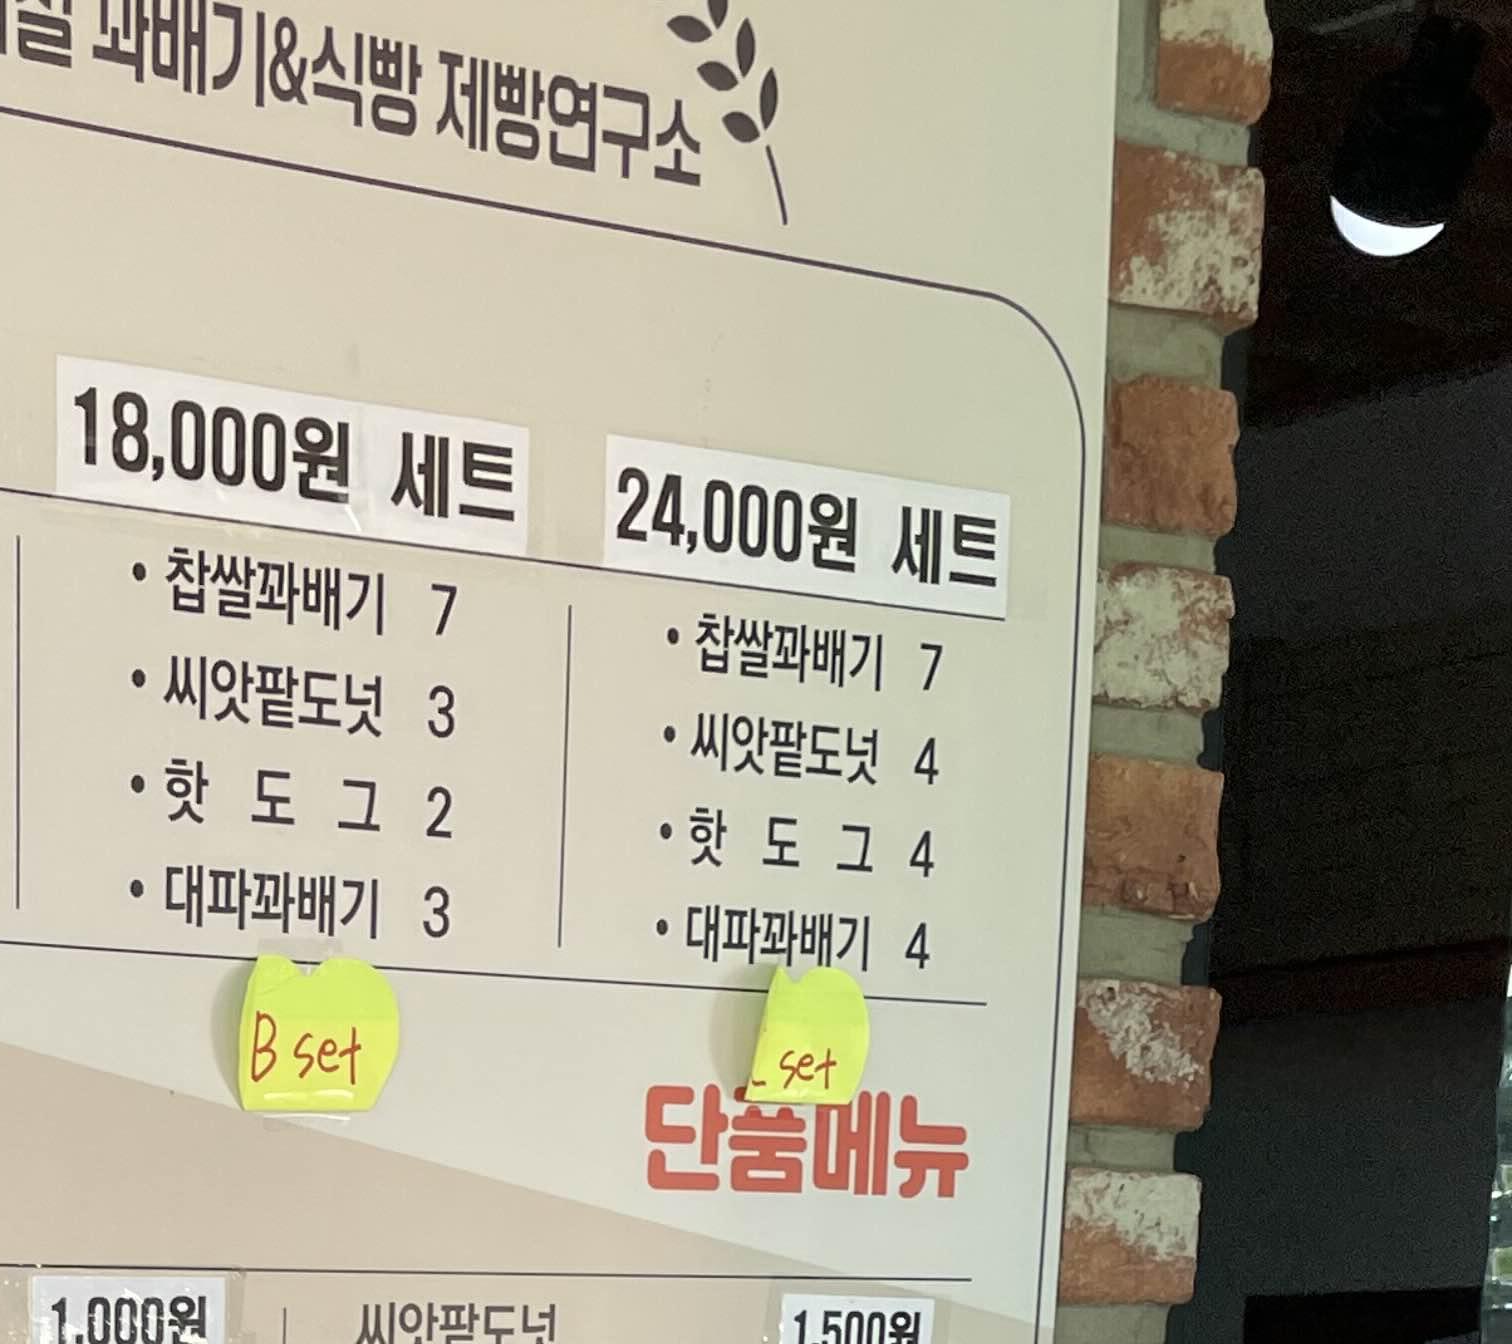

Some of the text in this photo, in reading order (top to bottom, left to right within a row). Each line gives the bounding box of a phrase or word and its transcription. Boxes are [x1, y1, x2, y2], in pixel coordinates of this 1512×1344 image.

[437, 51, 700, 186] 제빵연구소
[75, 387, 514, 521] 18,000원 세트
[617, 467, 996, 587] 24,000원 세트
[166, 547, 457, 635] 찹쌀꽈배기 7
[696, 613, 942, 691] 찹쌀꽈배기 7
[164, 656, 454, 738] 씨앗팥도넛 3
[691, 713, 938, 785] 씨앗팥도넛 4
[165, 759, 451, 838] 핫 도 그 2
[690, 807, 934, 877] 핫 도 그 4
[166, 865, 449, 939] 대파꽈배기 3
[687, 905, 930, 972] 대파꽈배기 4
[251, 1012, 363, 1084] B set
[779, 1047, 837, 1090] set
[645, 1084, 968, 1197] 단품메뉴
